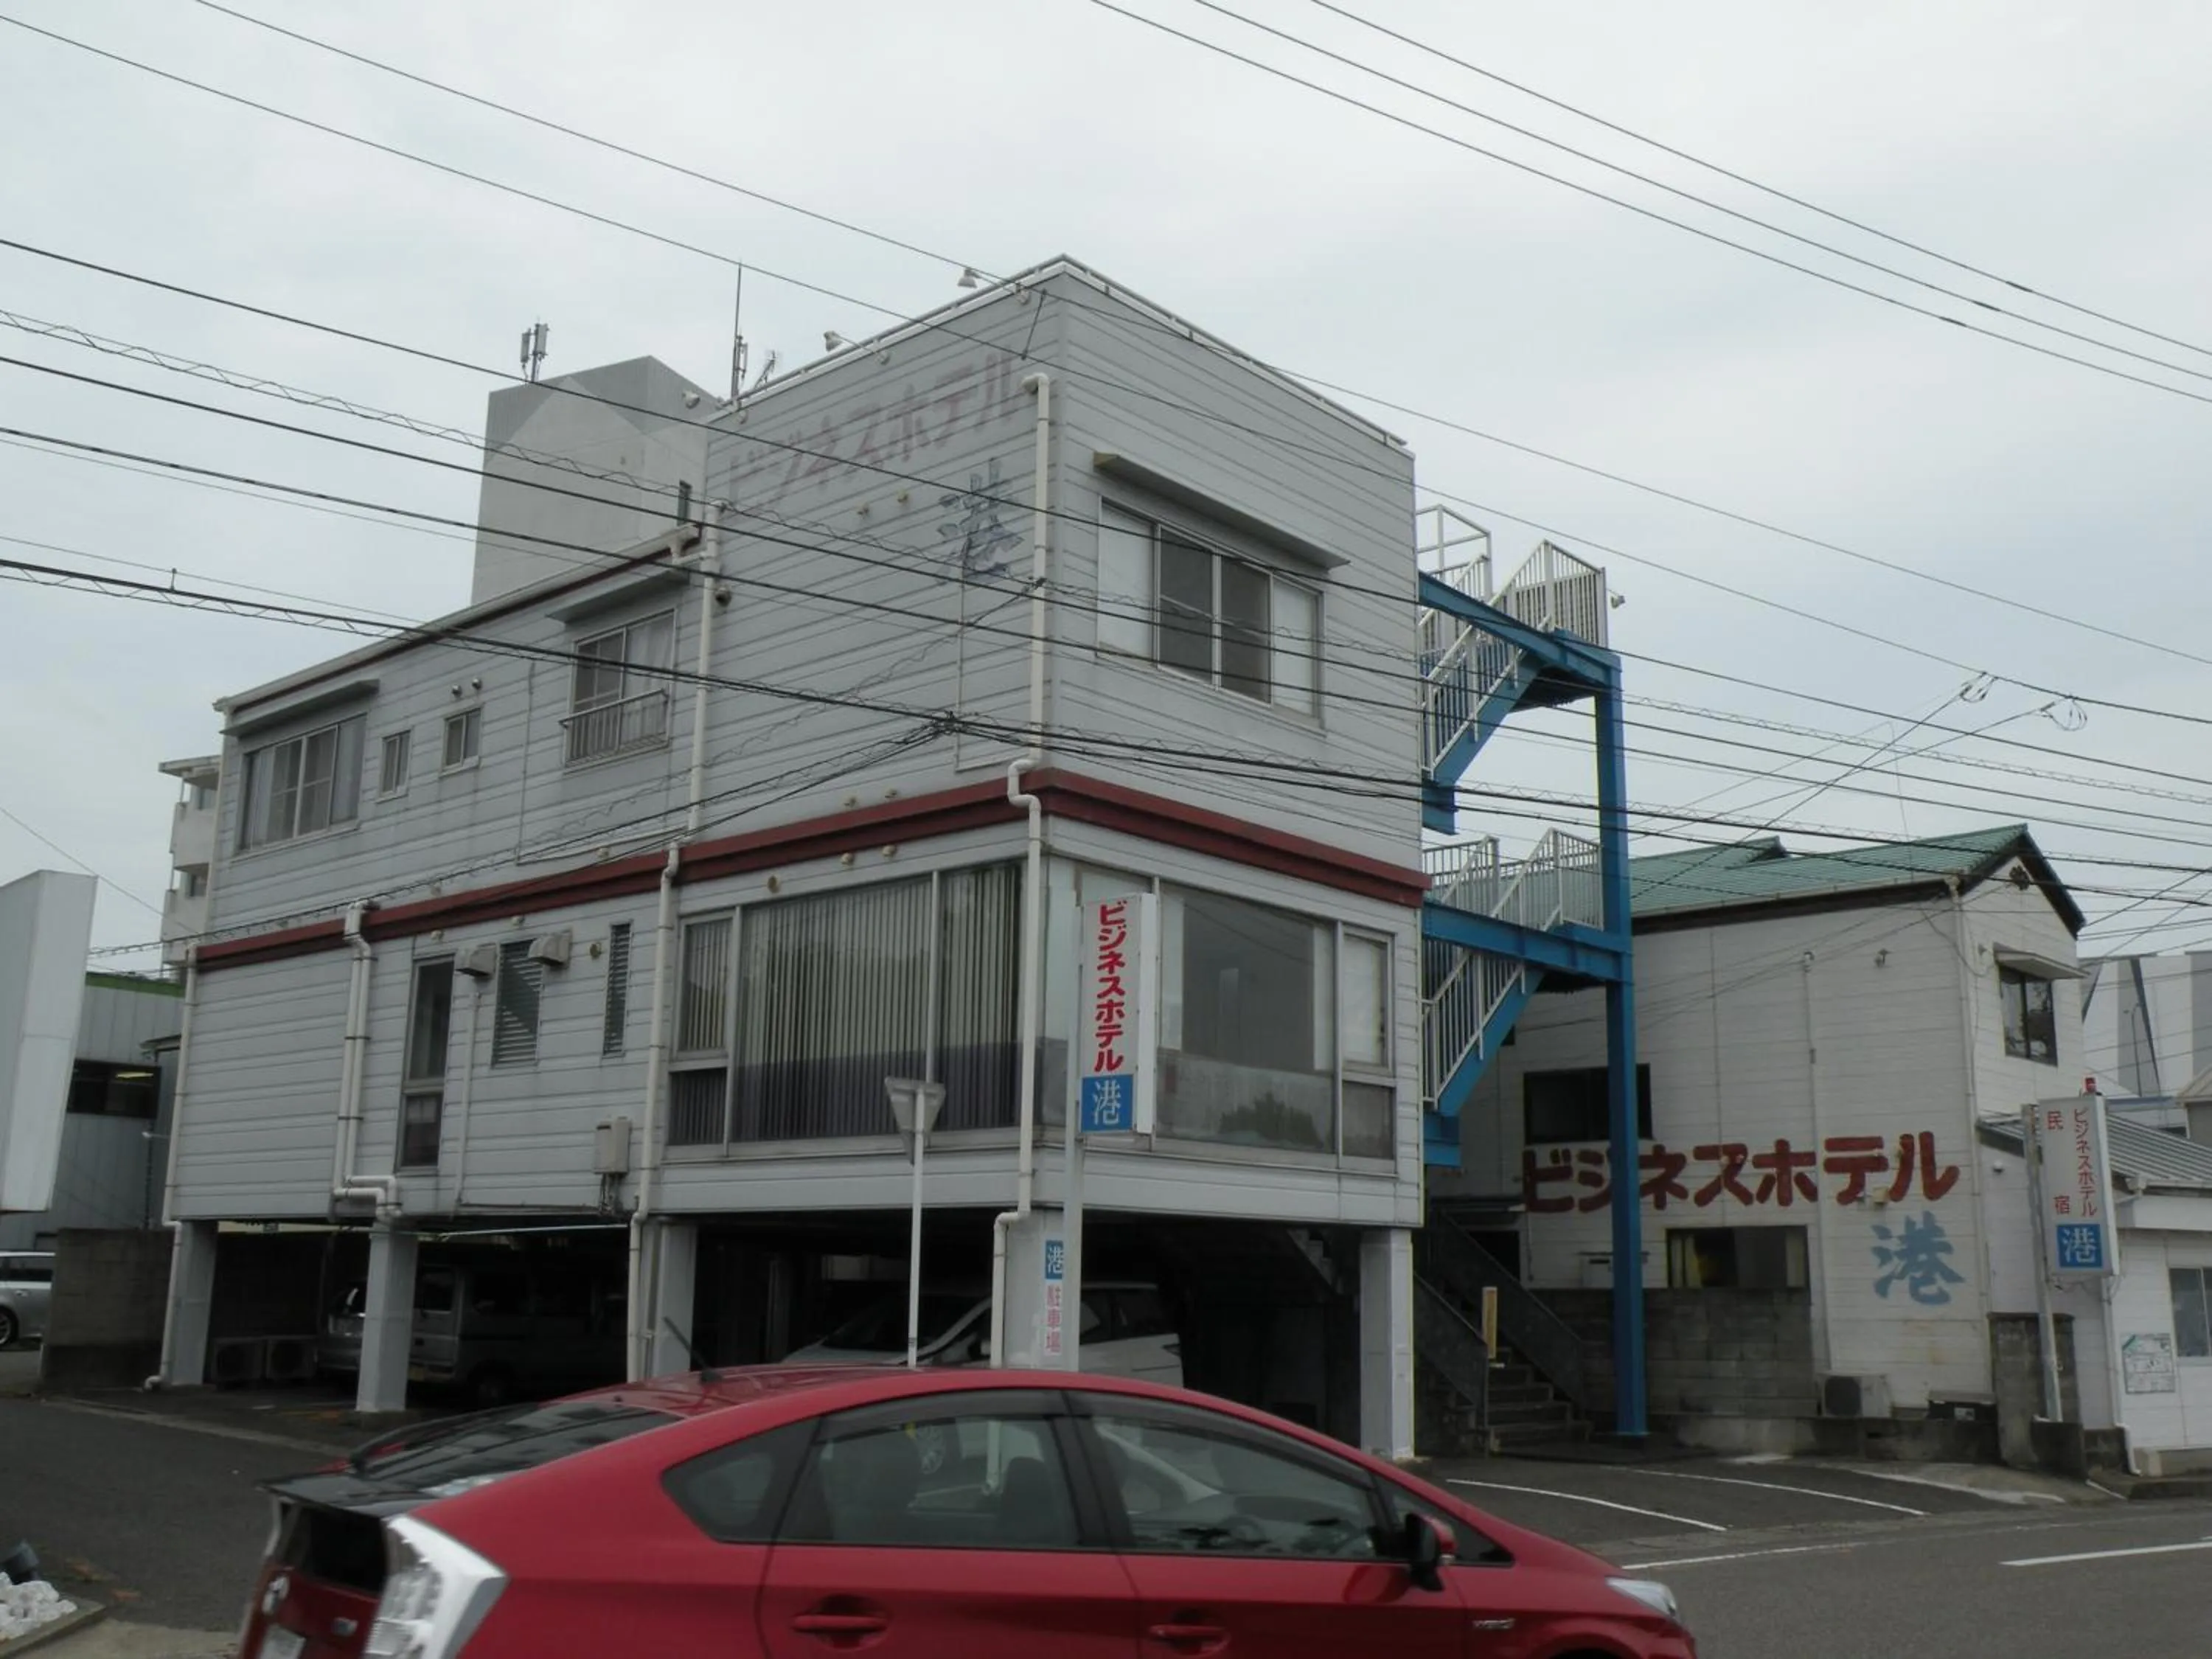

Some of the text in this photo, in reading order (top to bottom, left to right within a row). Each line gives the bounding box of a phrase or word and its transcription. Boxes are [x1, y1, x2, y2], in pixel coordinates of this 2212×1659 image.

[1094, 900, 1127, 1073] ビジネスホテル
[1093, 1079, 1121, 1126] 港
[2074, 1108, 2097, 1217] ビジネスホテル
[1048, 1245, 1063, 1274] 港
[1871, 1211, 1965, 1305] 港
[2062, 1227, 2096, 1263] 港
[1046, 1285, 1061, 1353] 駐車場
